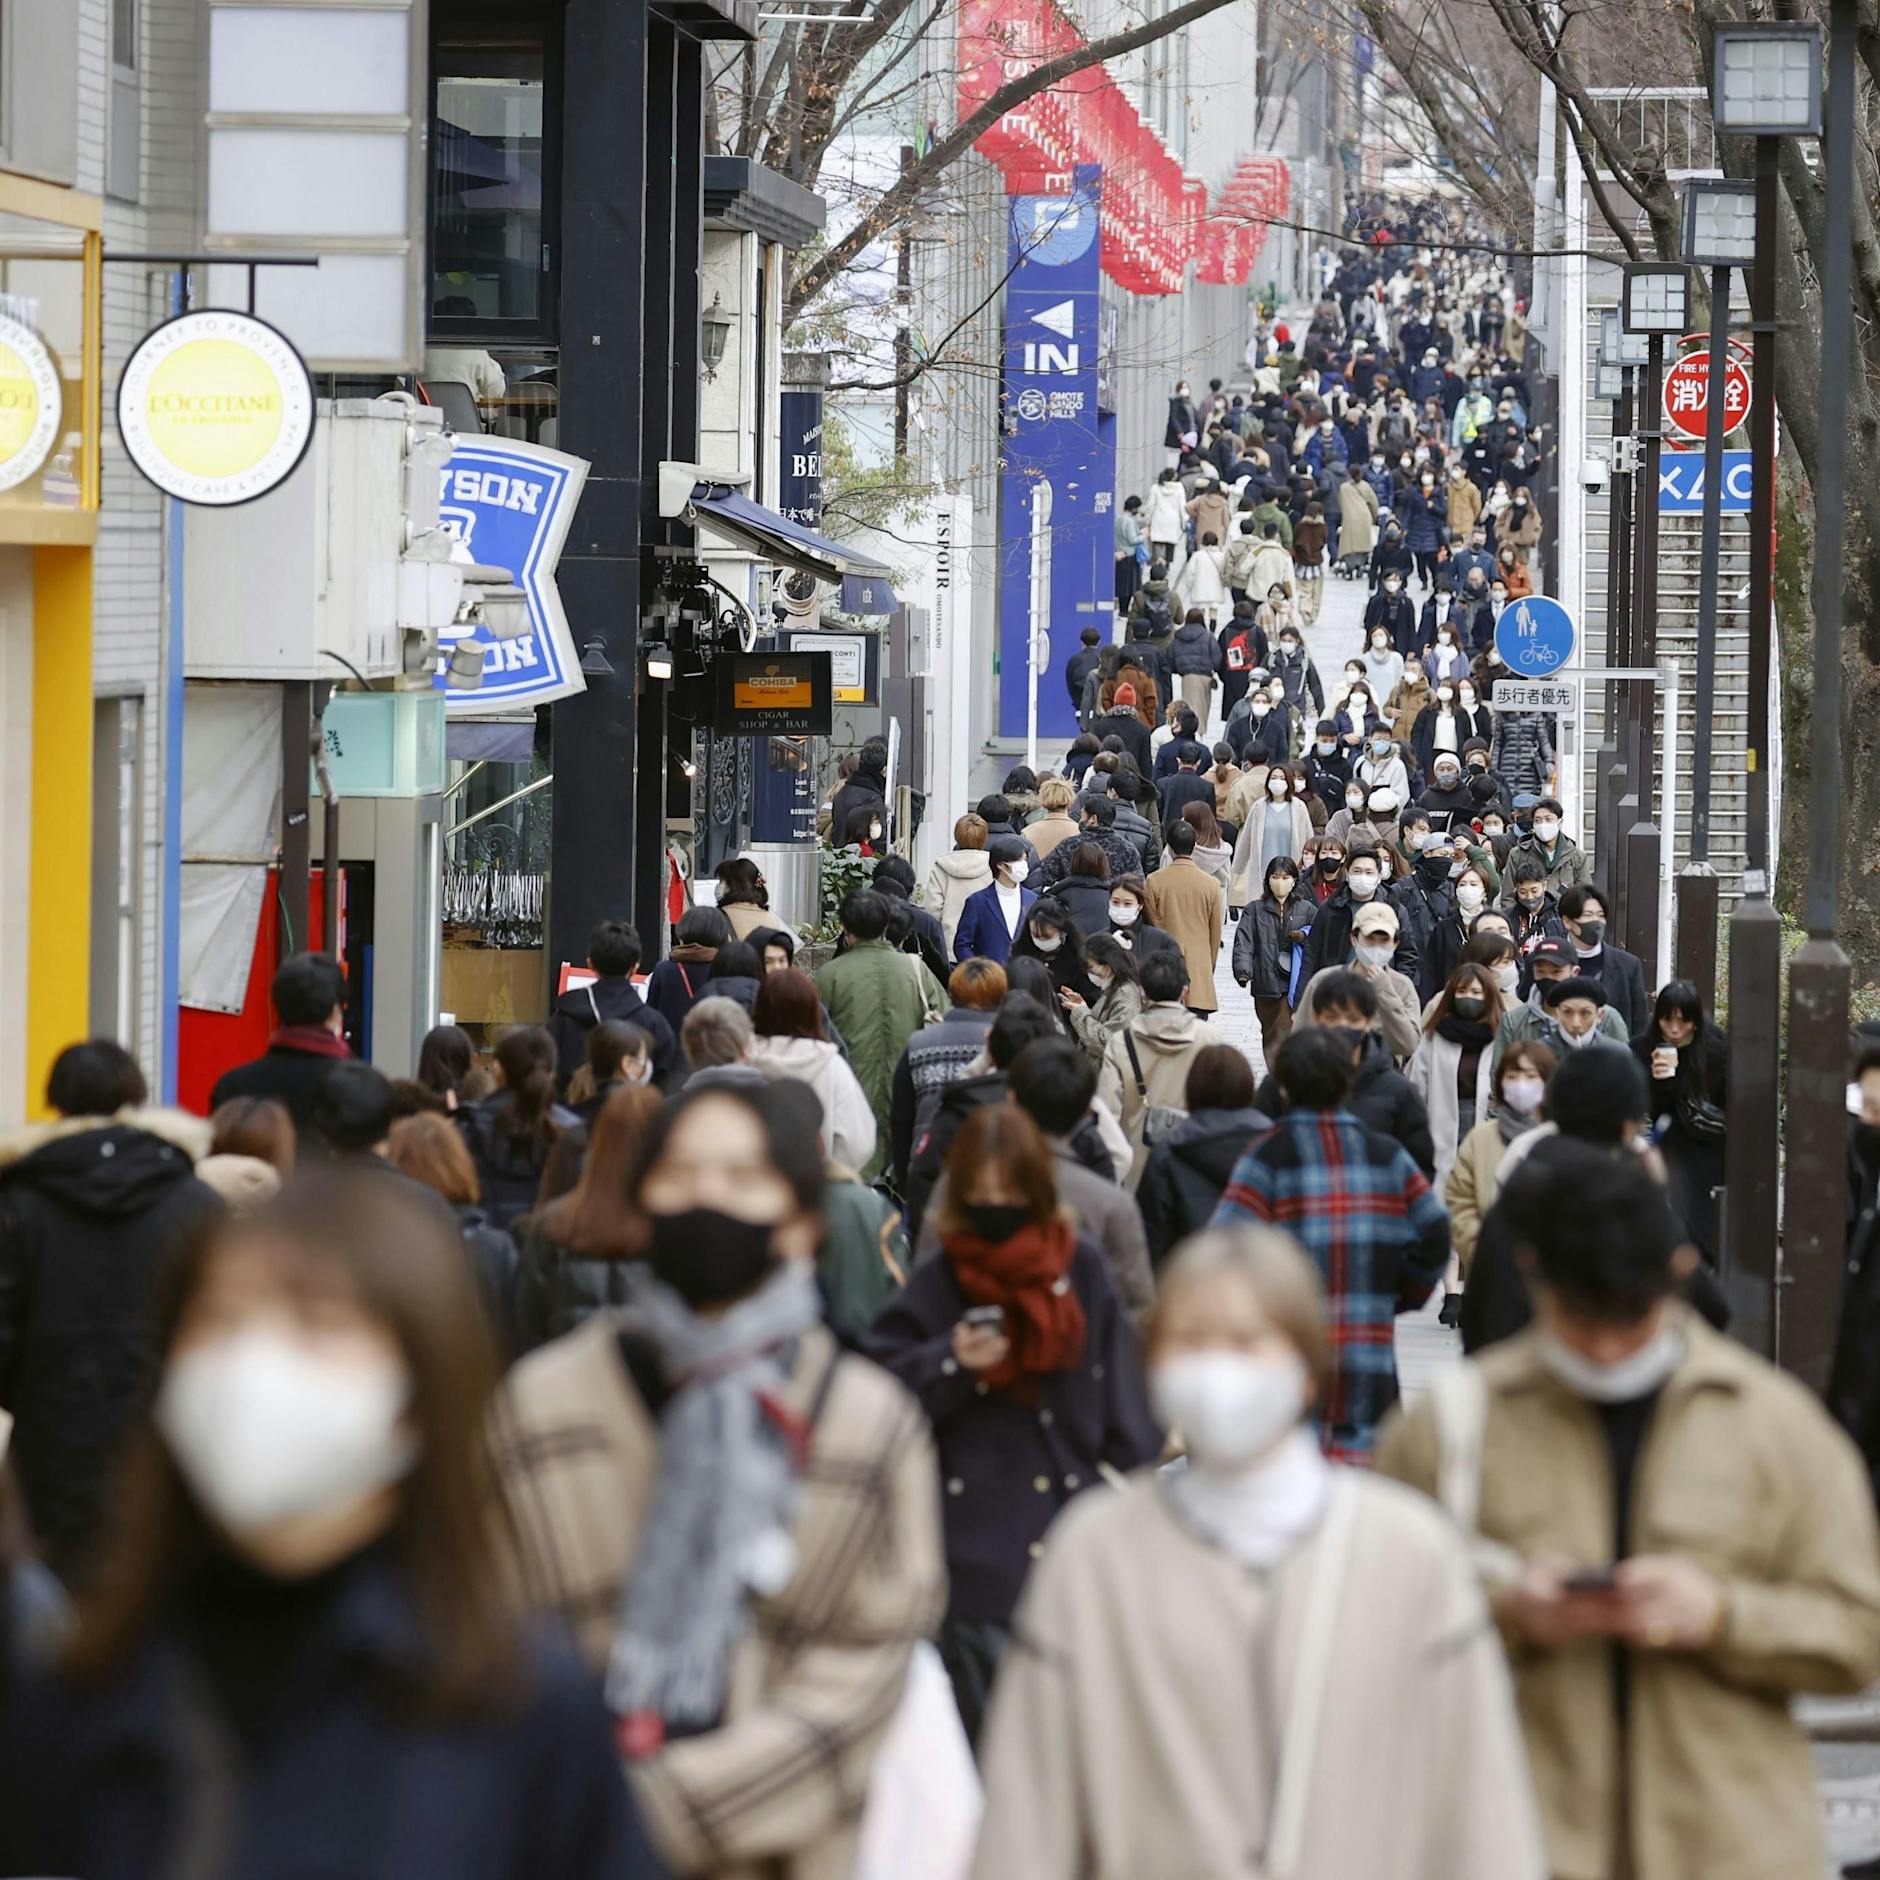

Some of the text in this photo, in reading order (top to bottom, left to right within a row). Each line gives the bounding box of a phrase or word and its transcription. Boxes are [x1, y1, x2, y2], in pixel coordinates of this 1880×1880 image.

[1024, 343, 1079, 376] IN
[1679, 363, 1697, 373] FIRE
[1050, 391, 1084, 401] OMOTE
[937, 513, 950, 589] ESPOIR
[750, 679, 796, 687] COHIBA
[1497, 687, 1571, 706] 歩行者優先
[758, 711, 790, 719] CIGAR
[739, 720, 769, 729] SHOP
[786, 720, 809, 729] BAR
